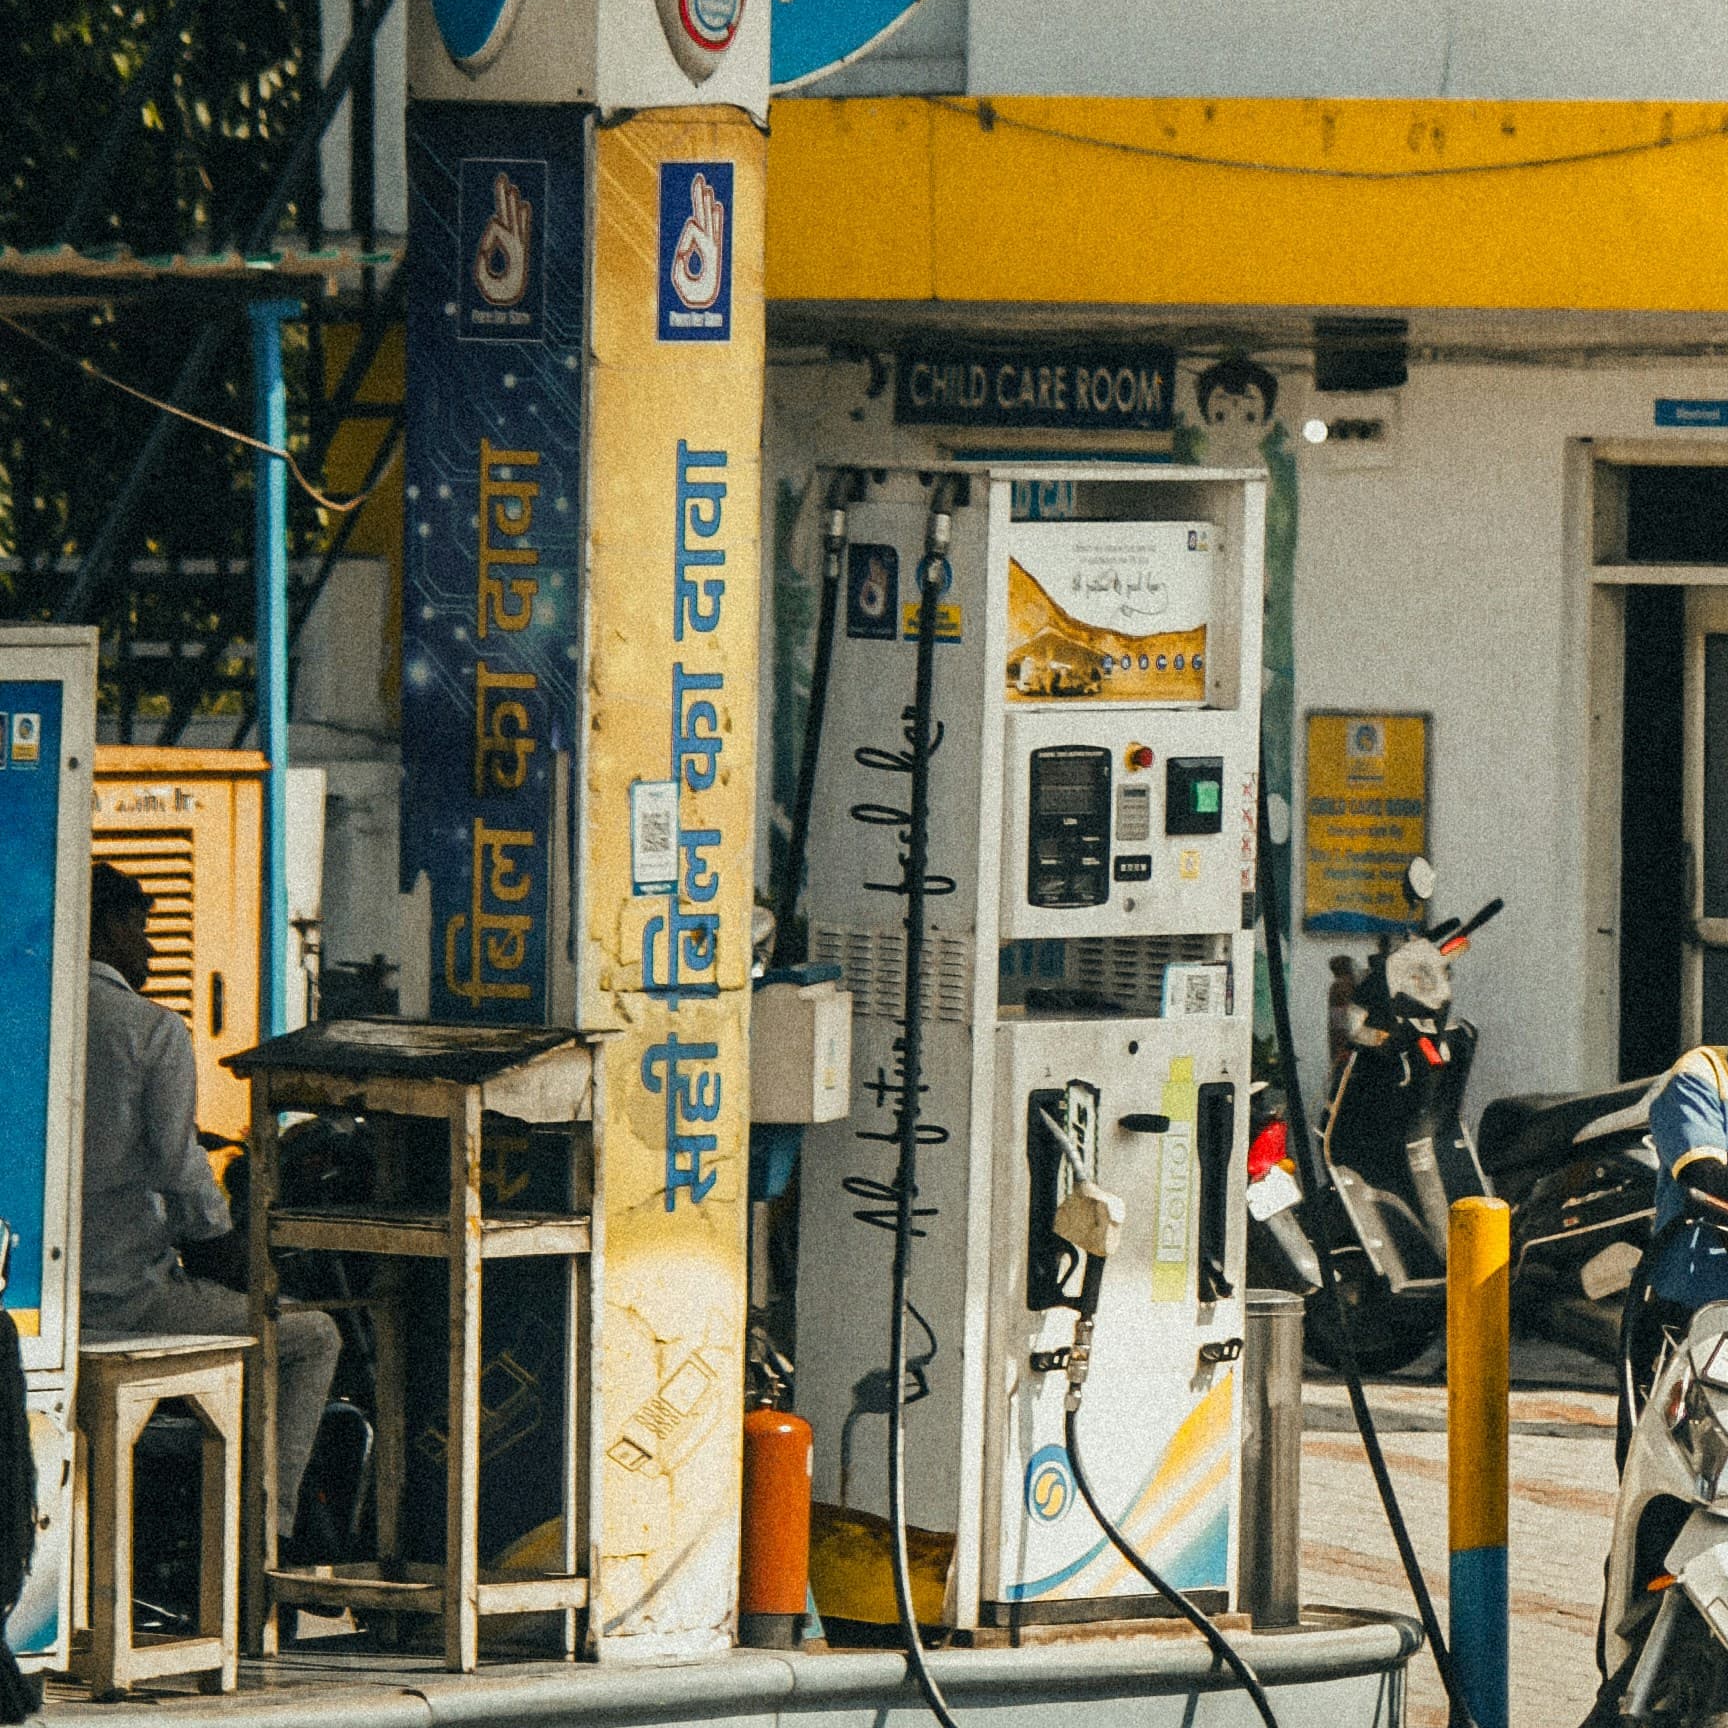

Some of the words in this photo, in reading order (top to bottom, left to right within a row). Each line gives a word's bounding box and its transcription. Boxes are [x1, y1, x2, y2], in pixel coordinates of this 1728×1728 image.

[909, 363, 988, 408] CHILD
[996, 364, 1068, 410] CARE
[1076, 367, 1163, 413] ROOM
[477, 437, 541, 638] दावा
[673, 439, 728, 641] दावा
[473, 660, 538, 797] का
[671, 662, 724, 790] का
[445, 816, 536, 1008] बिल
[642, 828, 722, 1011] बिल
[642, 1032, 720, 1213] सही
[1160, 1132, 1189, 1251] Petrol
